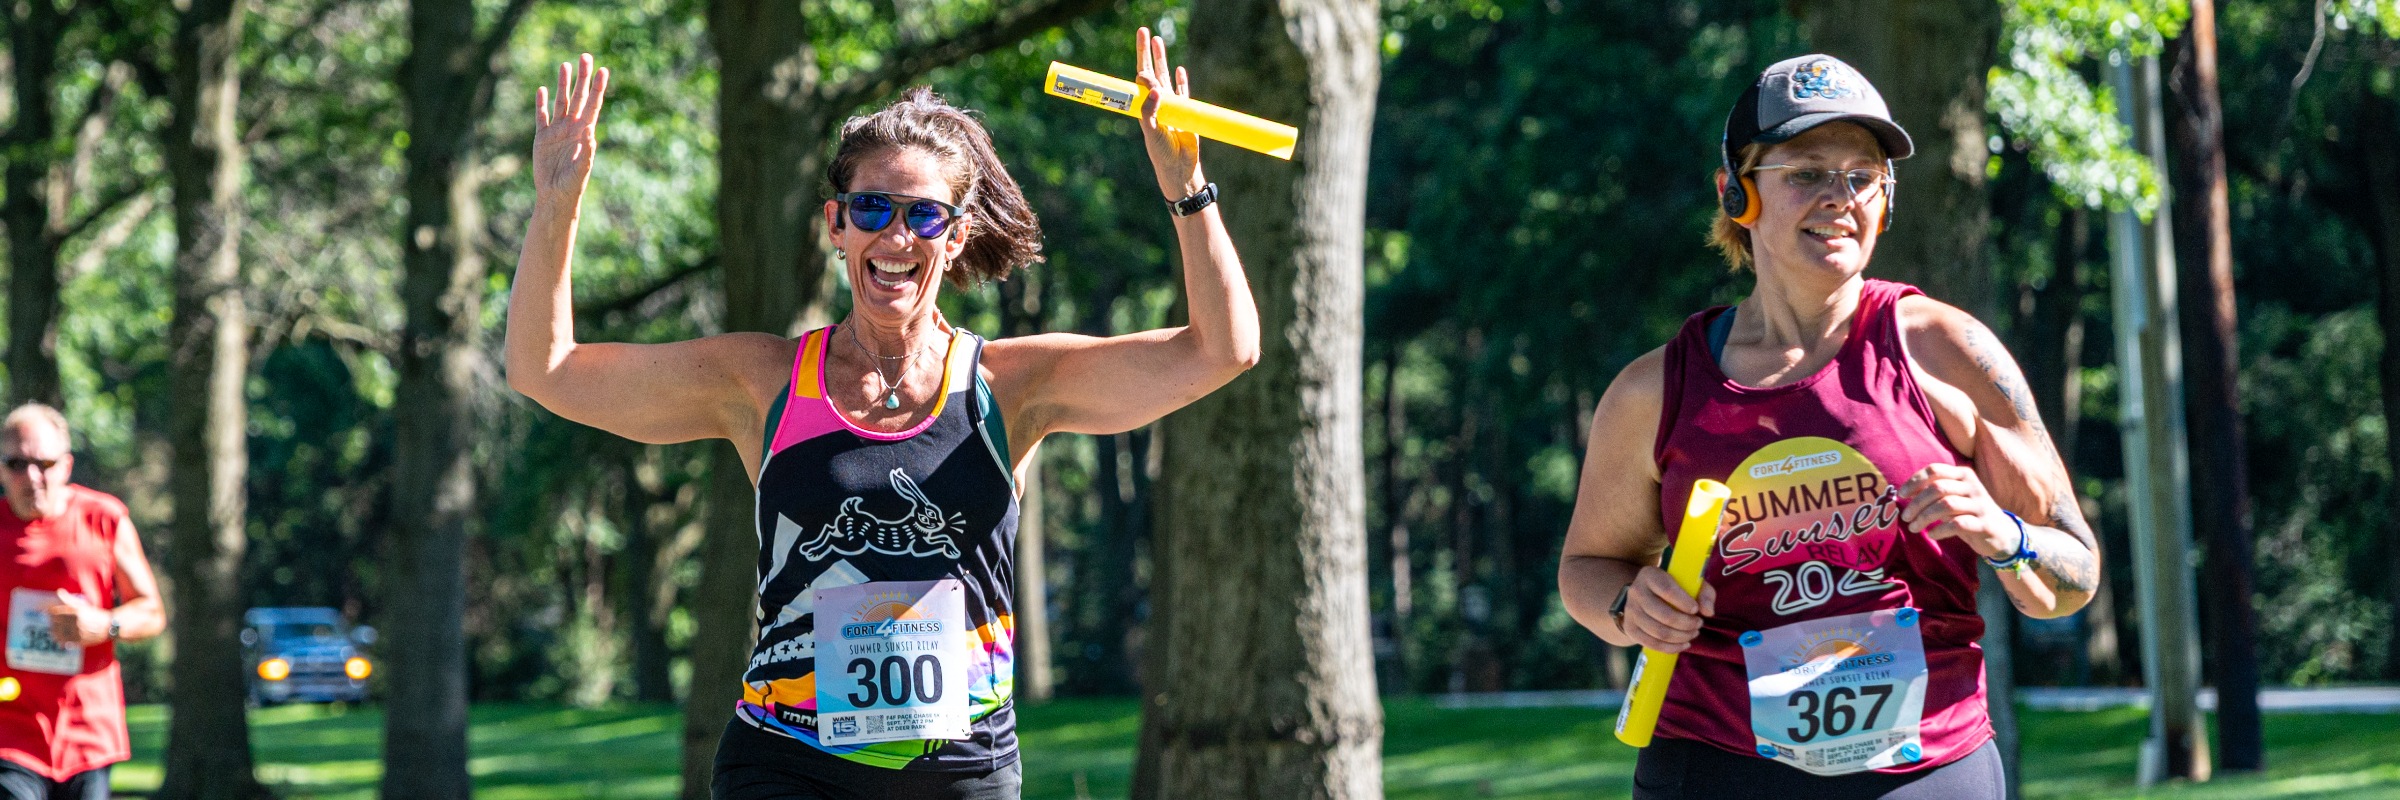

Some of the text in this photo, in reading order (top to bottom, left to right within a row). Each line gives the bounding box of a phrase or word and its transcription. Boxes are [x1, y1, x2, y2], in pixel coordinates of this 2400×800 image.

[1725, 472, 1880, 527] SUMMER
[1719, 485, 1899, 576] Sunset
[1805, 540, 1884, 568] RELAY
[849, 640, 939, 655] SUMMER SUNSET RELAY
[846, 654, 943, 708] 300
[1830, 673, 1861, 684] SUNSET
[1865, 670, 1891, 680] RELAY
[1787, 684, 1893, 743] 367
